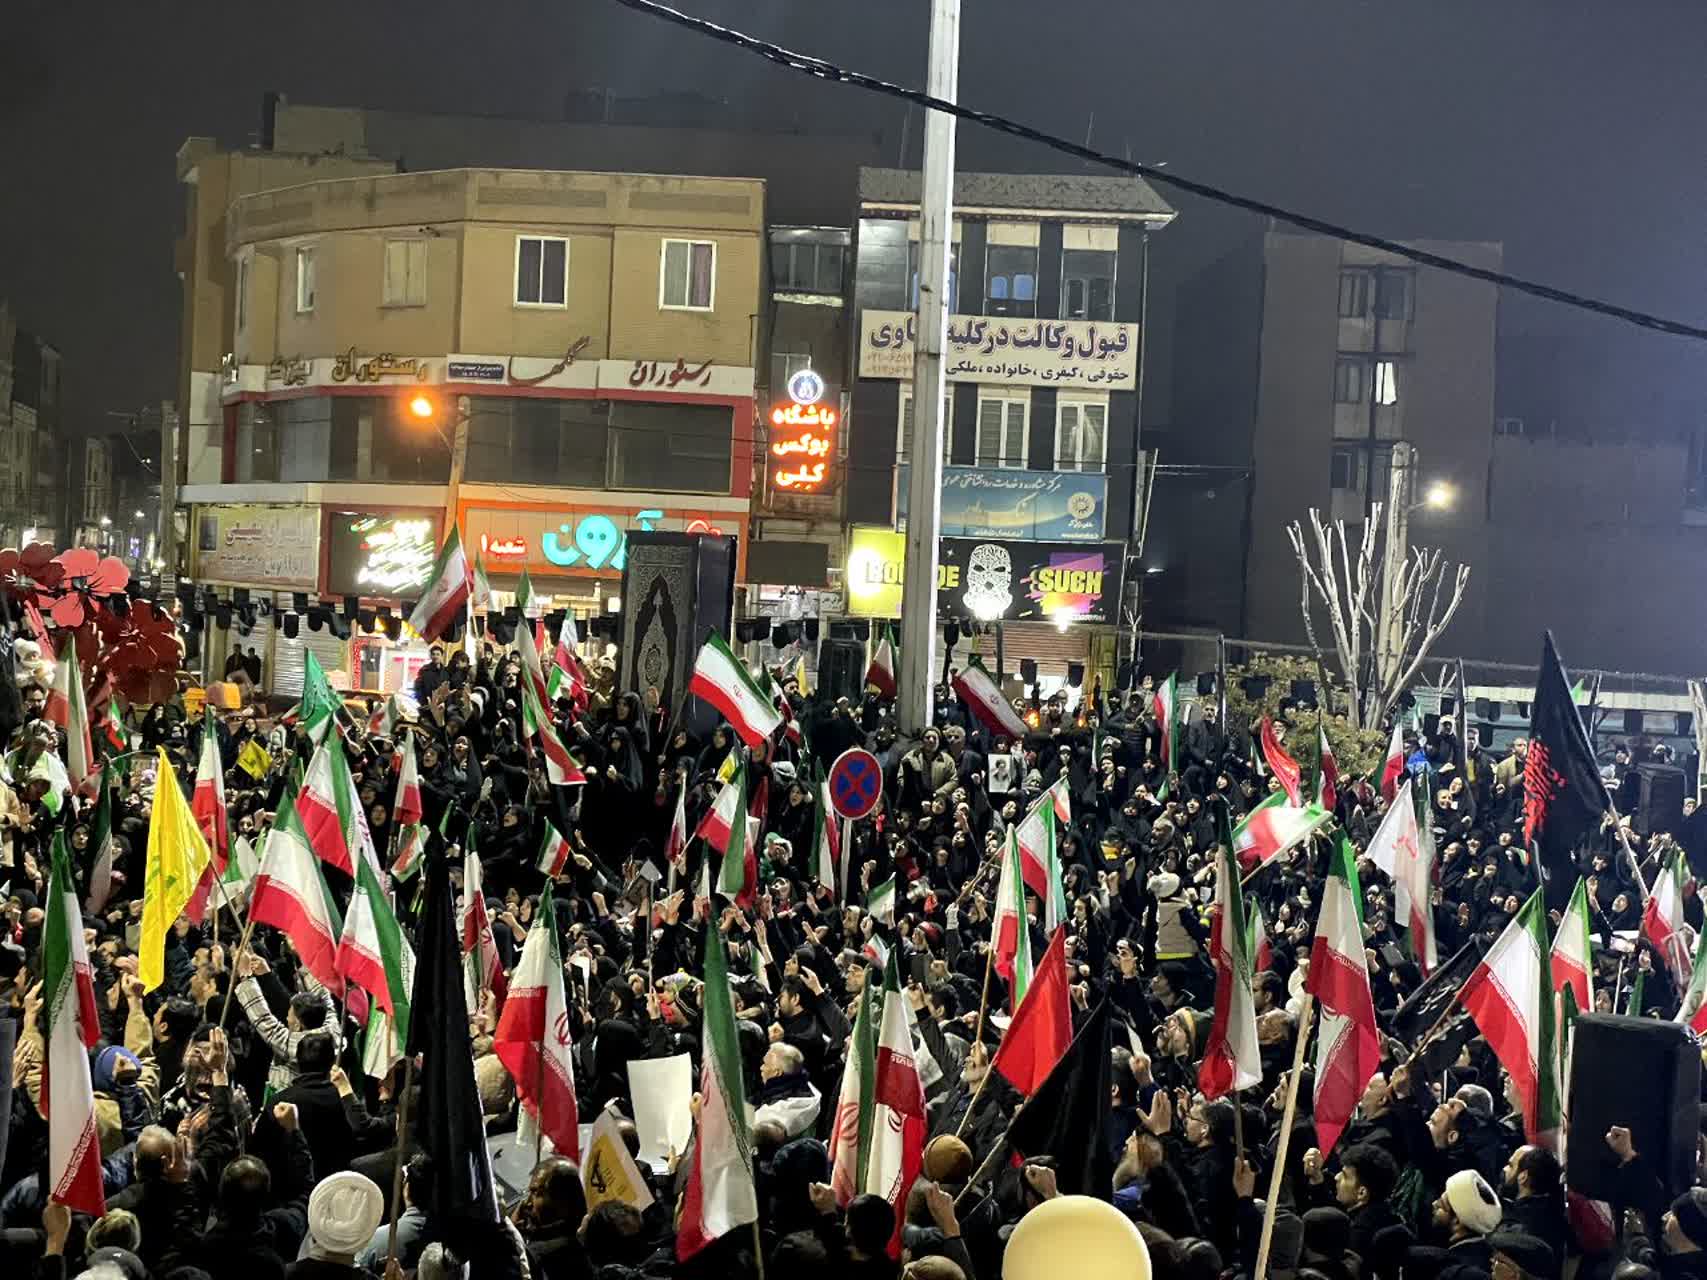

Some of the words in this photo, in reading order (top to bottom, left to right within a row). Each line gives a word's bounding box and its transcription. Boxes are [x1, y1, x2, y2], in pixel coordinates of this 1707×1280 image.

[982, 328, 1008, 354] در
[1013, 323, 1073, 358] وکالت
[1078, 326, 1128, 359] قبول
[331, 347, 429, 383] رستوران
[1087, 367, 1128, 383] حقوقی
[772, 403, 835, 430] باشگاه
[772, 433, 829, 457] بوکس
